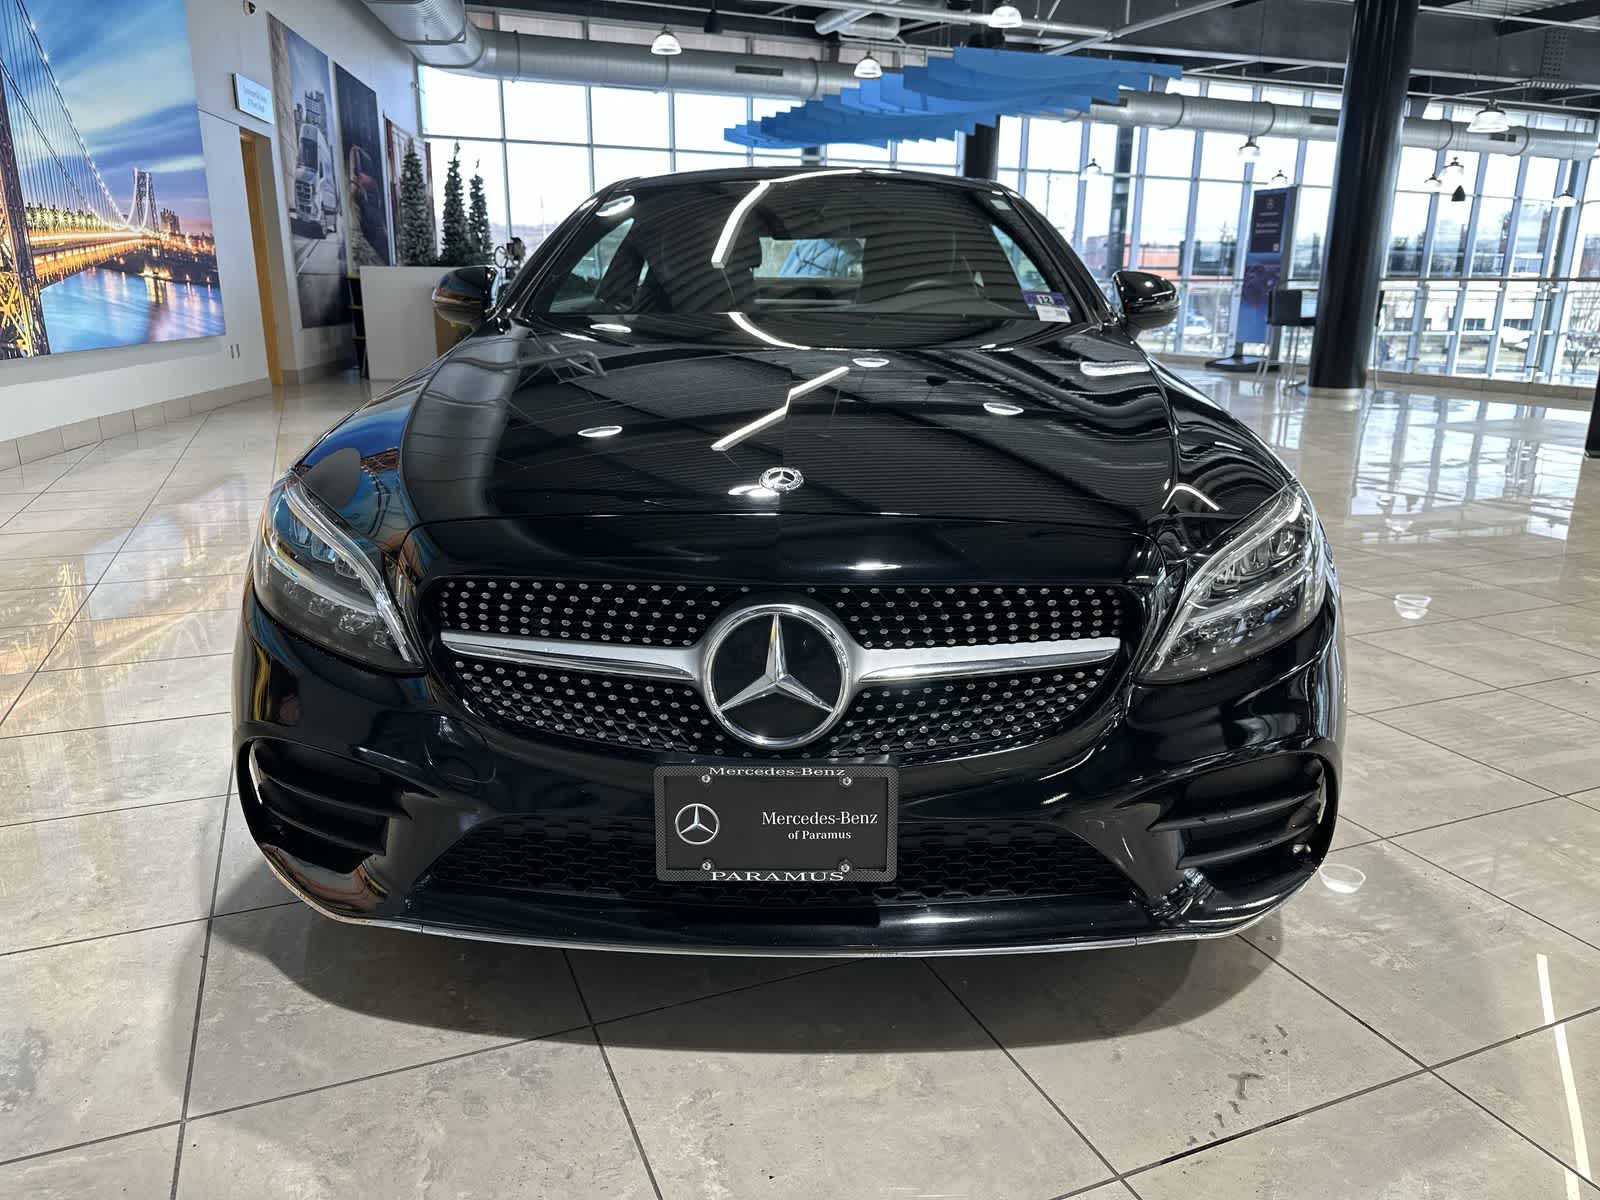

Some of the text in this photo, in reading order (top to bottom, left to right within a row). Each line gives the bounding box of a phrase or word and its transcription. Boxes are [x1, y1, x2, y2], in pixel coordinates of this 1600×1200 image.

[709, 767, 846, 776] Mercedes-Benz
[762, 811, 878, 825] Mercedes-Benz
[788, 830, 851, 840] of Paramus
[712, 871, 844, 881] PARAMUS
